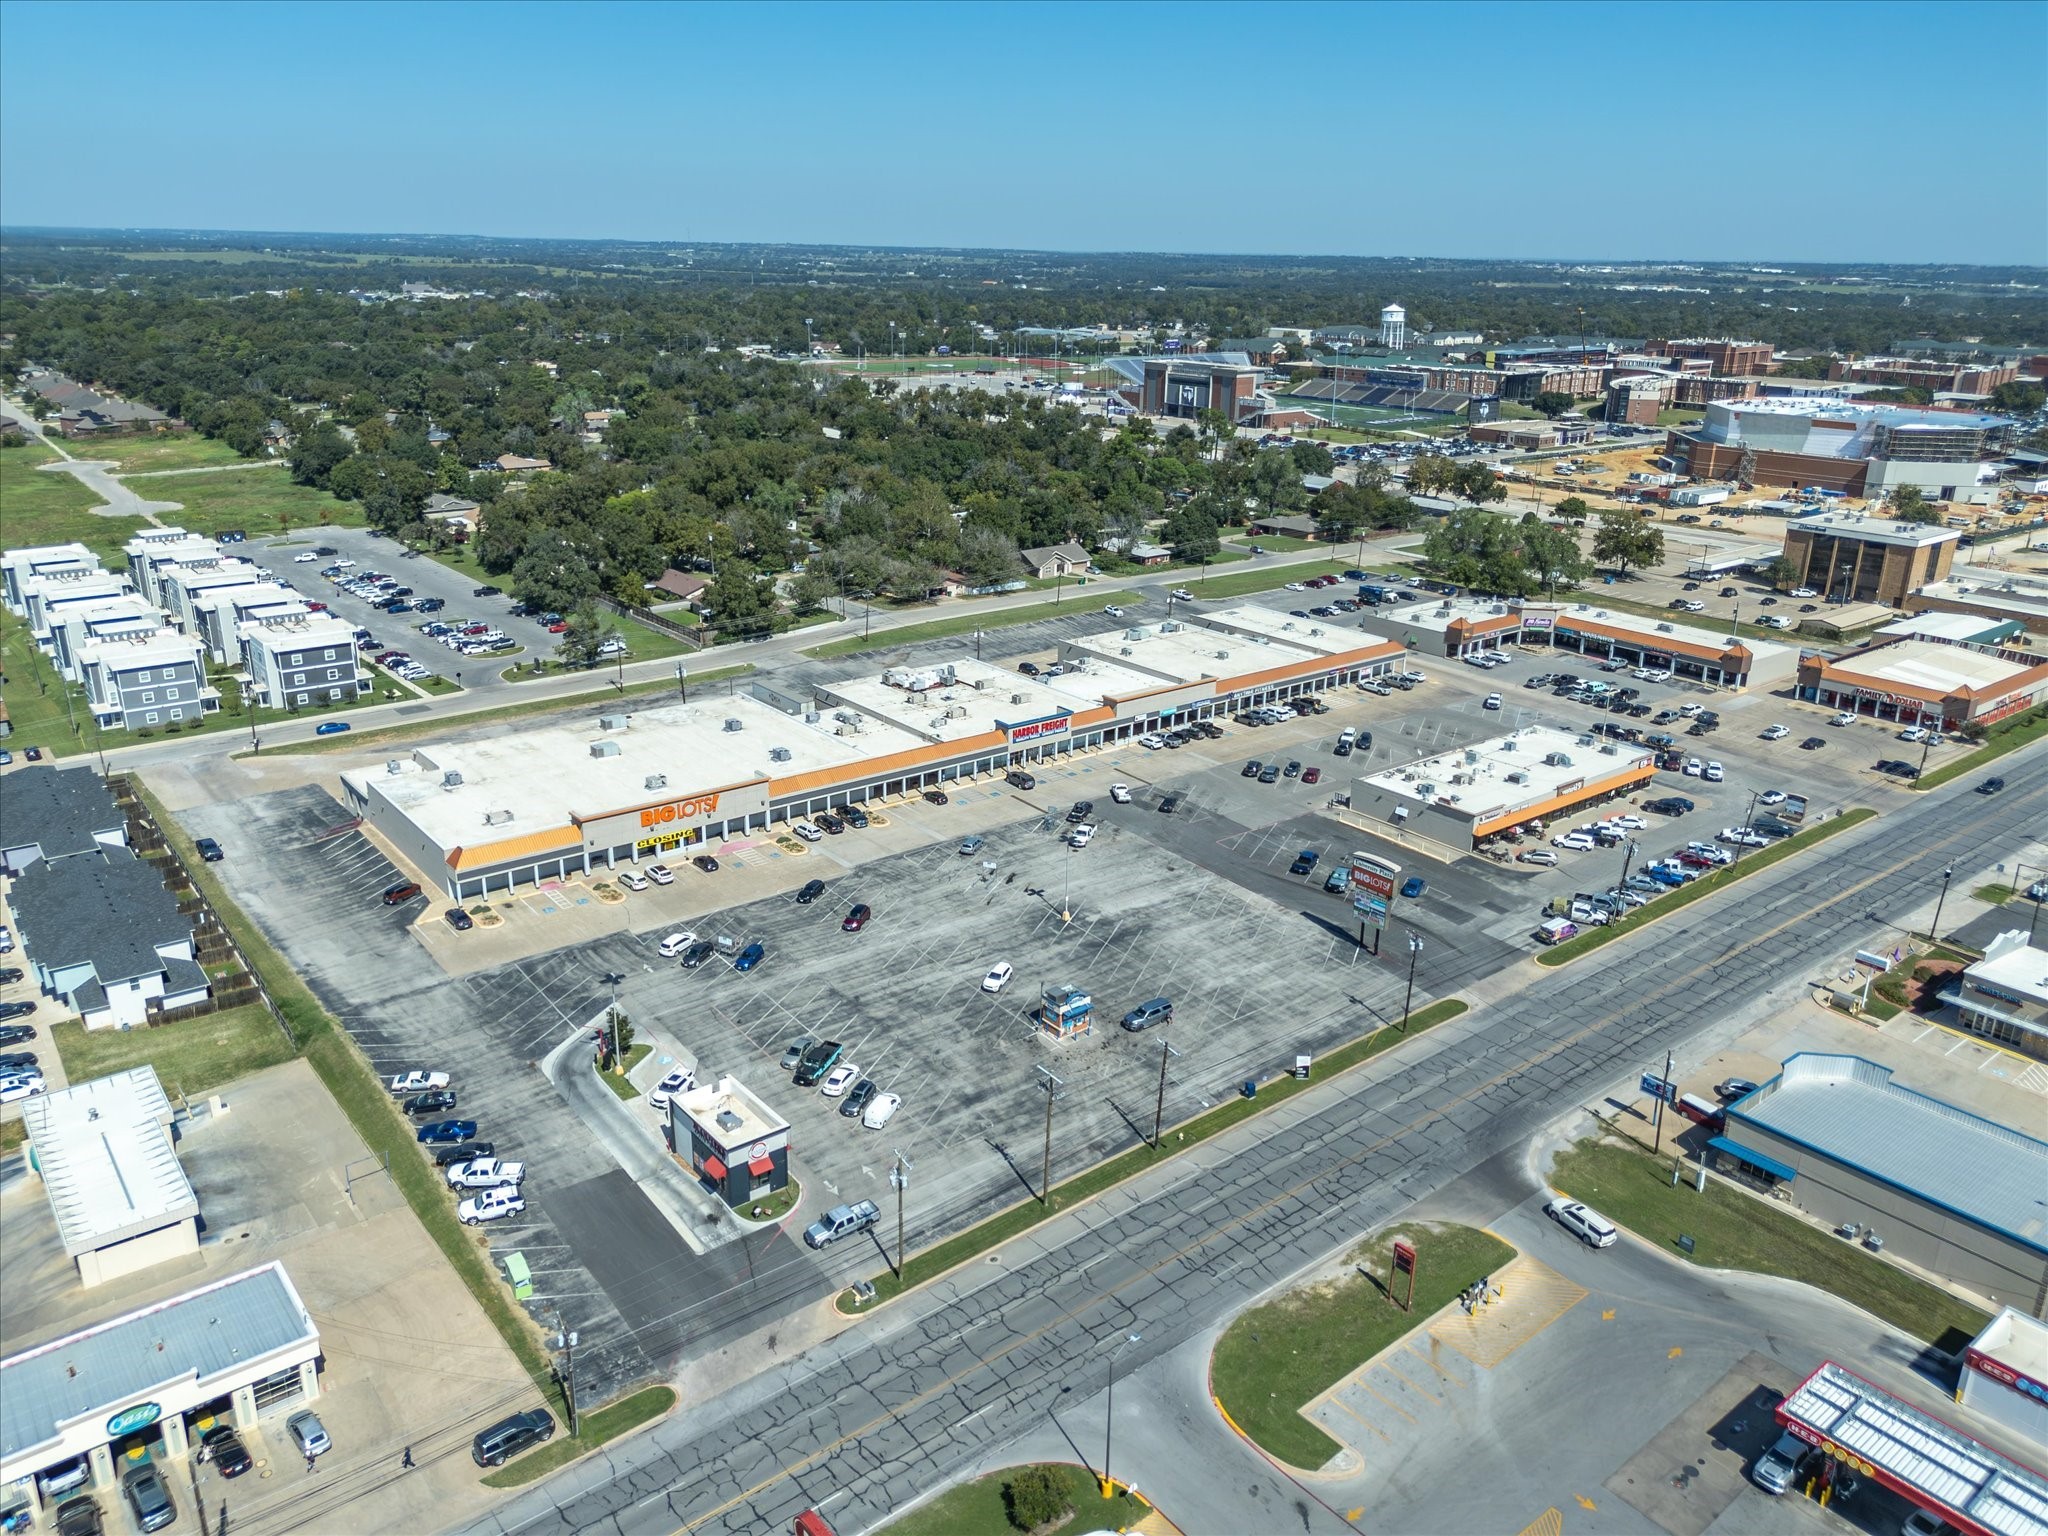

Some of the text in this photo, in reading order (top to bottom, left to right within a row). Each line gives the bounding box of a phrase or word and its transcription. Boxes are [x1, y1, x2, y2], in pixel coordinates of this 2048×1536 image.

[1855, 688, 1924, 709] FAMILY DOLLAR
[1012, 724, 1040, 739] HARBOR
[1041, 718, 1069, 733] FREIGHT
[640, 793, 720, 828] BIG LOTS!
[637, 829, 694, 848] CLOSING
[1354, 870, 1371, 883] BIG
[1370, 877, 1391, 892] LOTS!
[108, 1404, 160, 1434] Oasis
